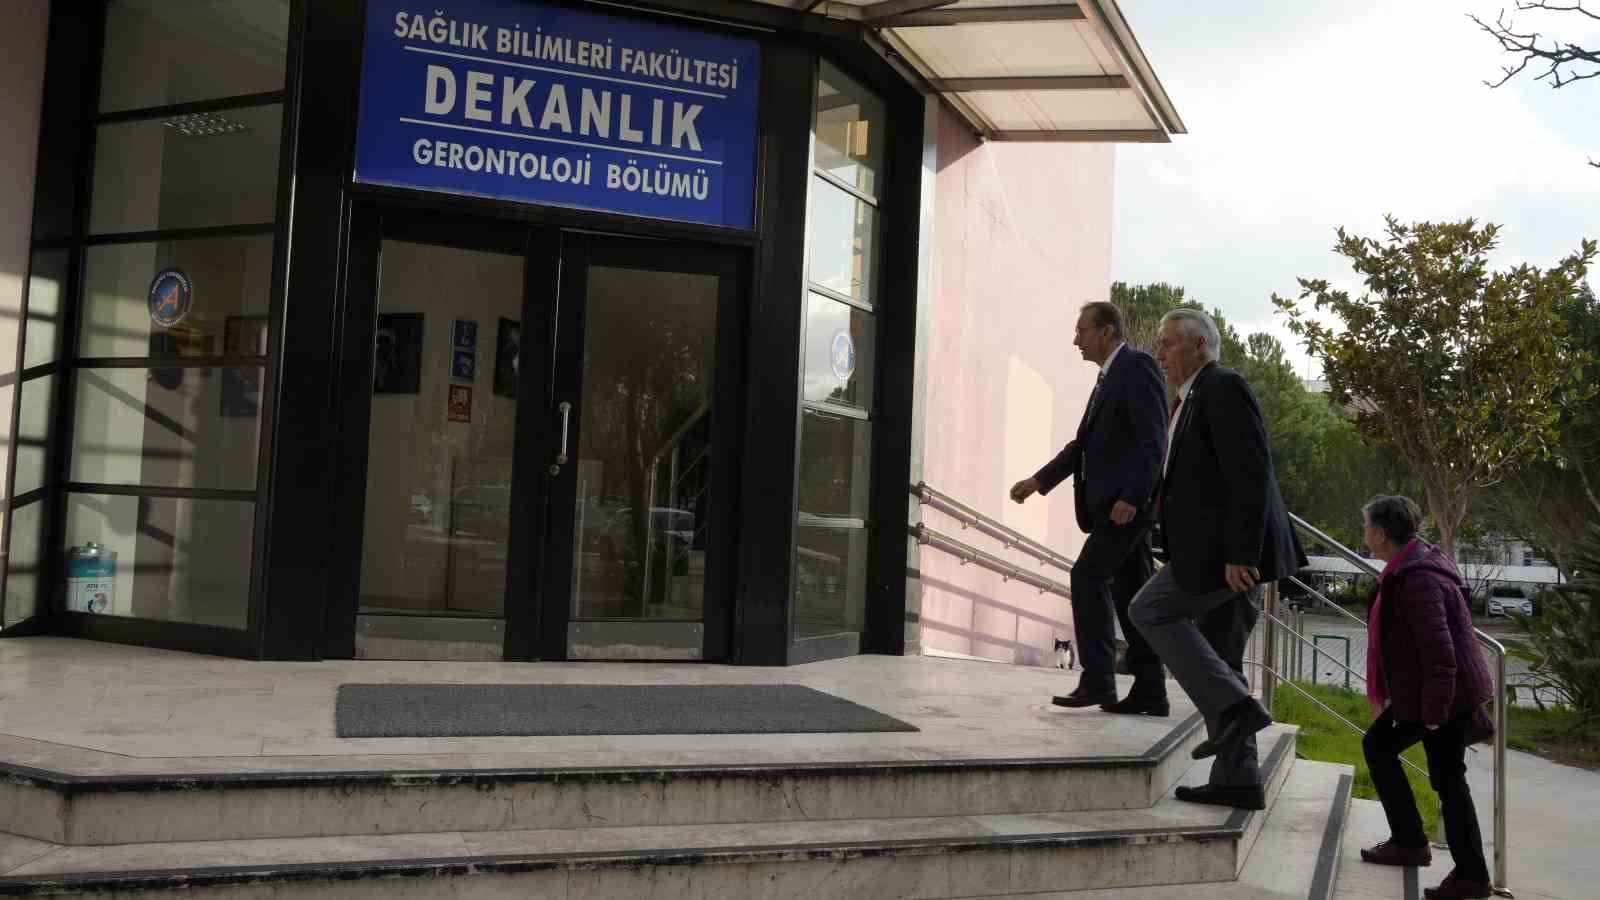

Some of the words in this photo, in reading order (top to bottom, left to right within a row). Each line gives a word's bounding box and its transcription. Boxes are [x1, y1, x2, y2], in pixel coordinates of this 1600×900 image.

[394, 10, 489, 50] SAĞLIK
[496, 25, 612, 70] BİLİMLERİ
[620, 48, 738, 90] FAKÜLTESİ
[424, 64, 704, 153] DEKANLIK
[413, 138, 592, 187] GERONTOLOJİ
[606, 161, 709, 201] BÖLÜMÜ
